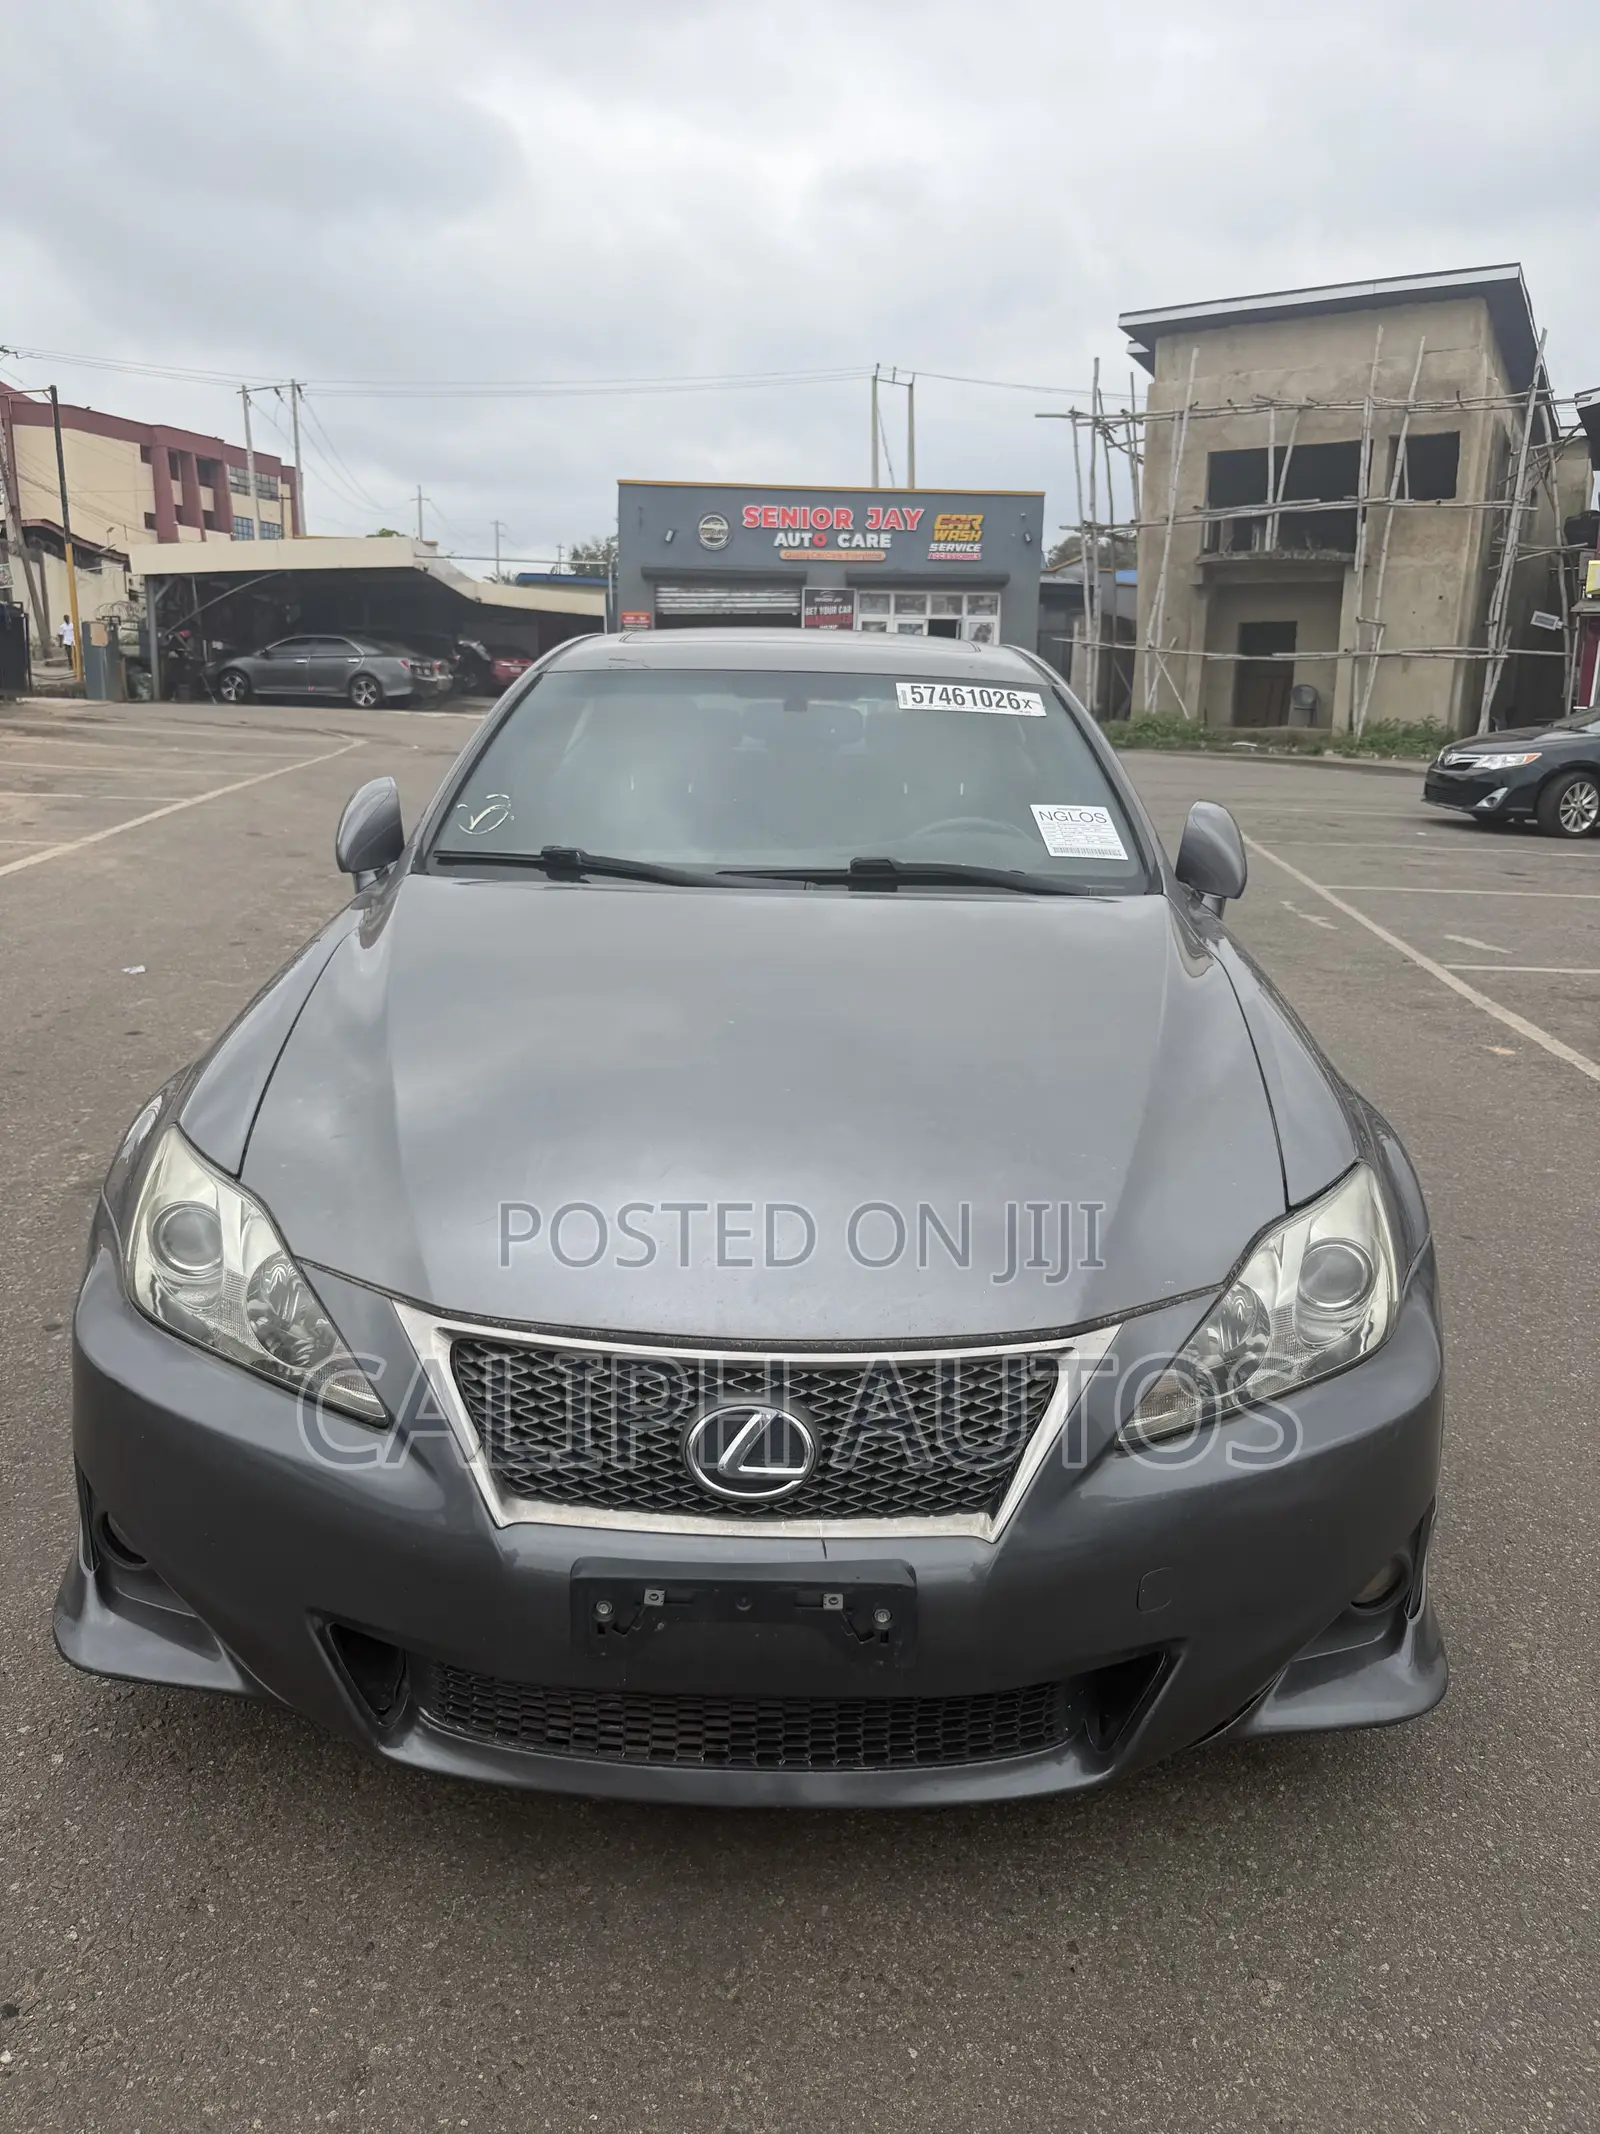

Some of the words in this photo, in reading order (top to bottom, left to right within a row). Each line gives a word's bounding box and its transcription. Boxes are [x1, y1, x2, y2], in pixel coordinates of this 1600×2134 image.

[742, 505, 854, 530] SENIOR
[865, 507, 925, 531] JAY
[934, 513, 984, 531] CAR
[773, 532, 827, 548] AUTO
[837, 533, 892, 548] CARE
[933, 530, 982, 541] WASH
[929, 543, 982, 552] SERVICE
[1038, 810, 1107, 824] NGLOS
